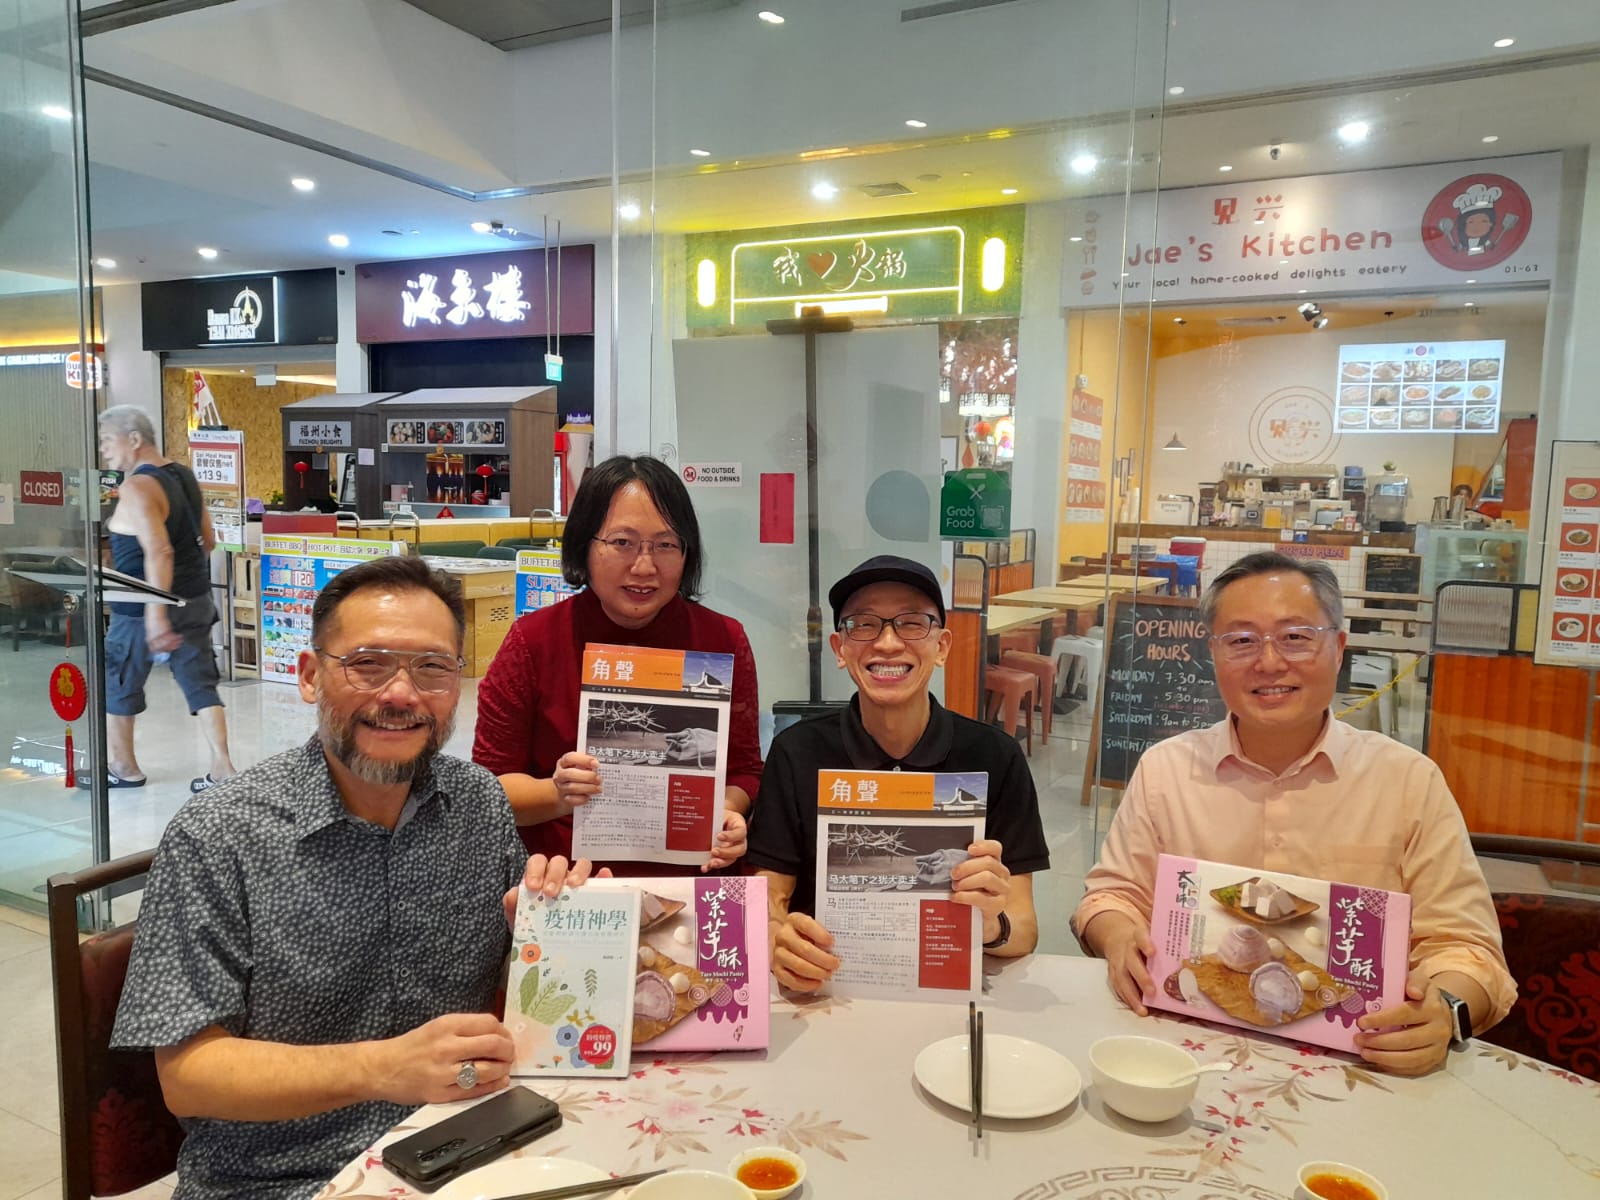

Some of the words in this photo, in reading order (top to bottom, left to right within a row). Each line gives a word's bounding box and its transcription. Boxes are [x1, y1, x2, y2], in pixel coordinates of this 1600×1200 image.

[1128, 235, 1213, 266] Jae's
[1241, 228, 1392, 258] Kitchen
[1113, 281, 1140, 290] Yur
[1191, 271, 1279, 286] home-cooked
[1290, 267, 1346, 281] delights
[1359, 264, 1407, 276] eatery
[1504, 264, 1539, 274] 01-63
[300, 424, 341, 438] 福州小食
[23, 481, 60, 498] CLOSED
[946, 505, 975, 517] Grab
[946, 518, 975, 529] Food
[323, 544, 337, 552] POT
[521, 557, 549, 566] BUFFET
[1135, 619, 1207, 639] OPENING
[1147, 643, 1191, 662] HOURS
[591, 658, 635, 682] 角聲
[1110, 691, 1143, 703] FRIDAY
[1193, 696, 1209, 704] pm
[1109, 711, 1153, 726] SATURDAY
[829, 778, 879, 803] 角聲
[544, 908, 628, 931] 疫情神學
[700, 887, 742, 970] 紫芋酥
[1331, 897, 1377, 981] 紫芋酥
[592, 1041, 612, 1056] 99
